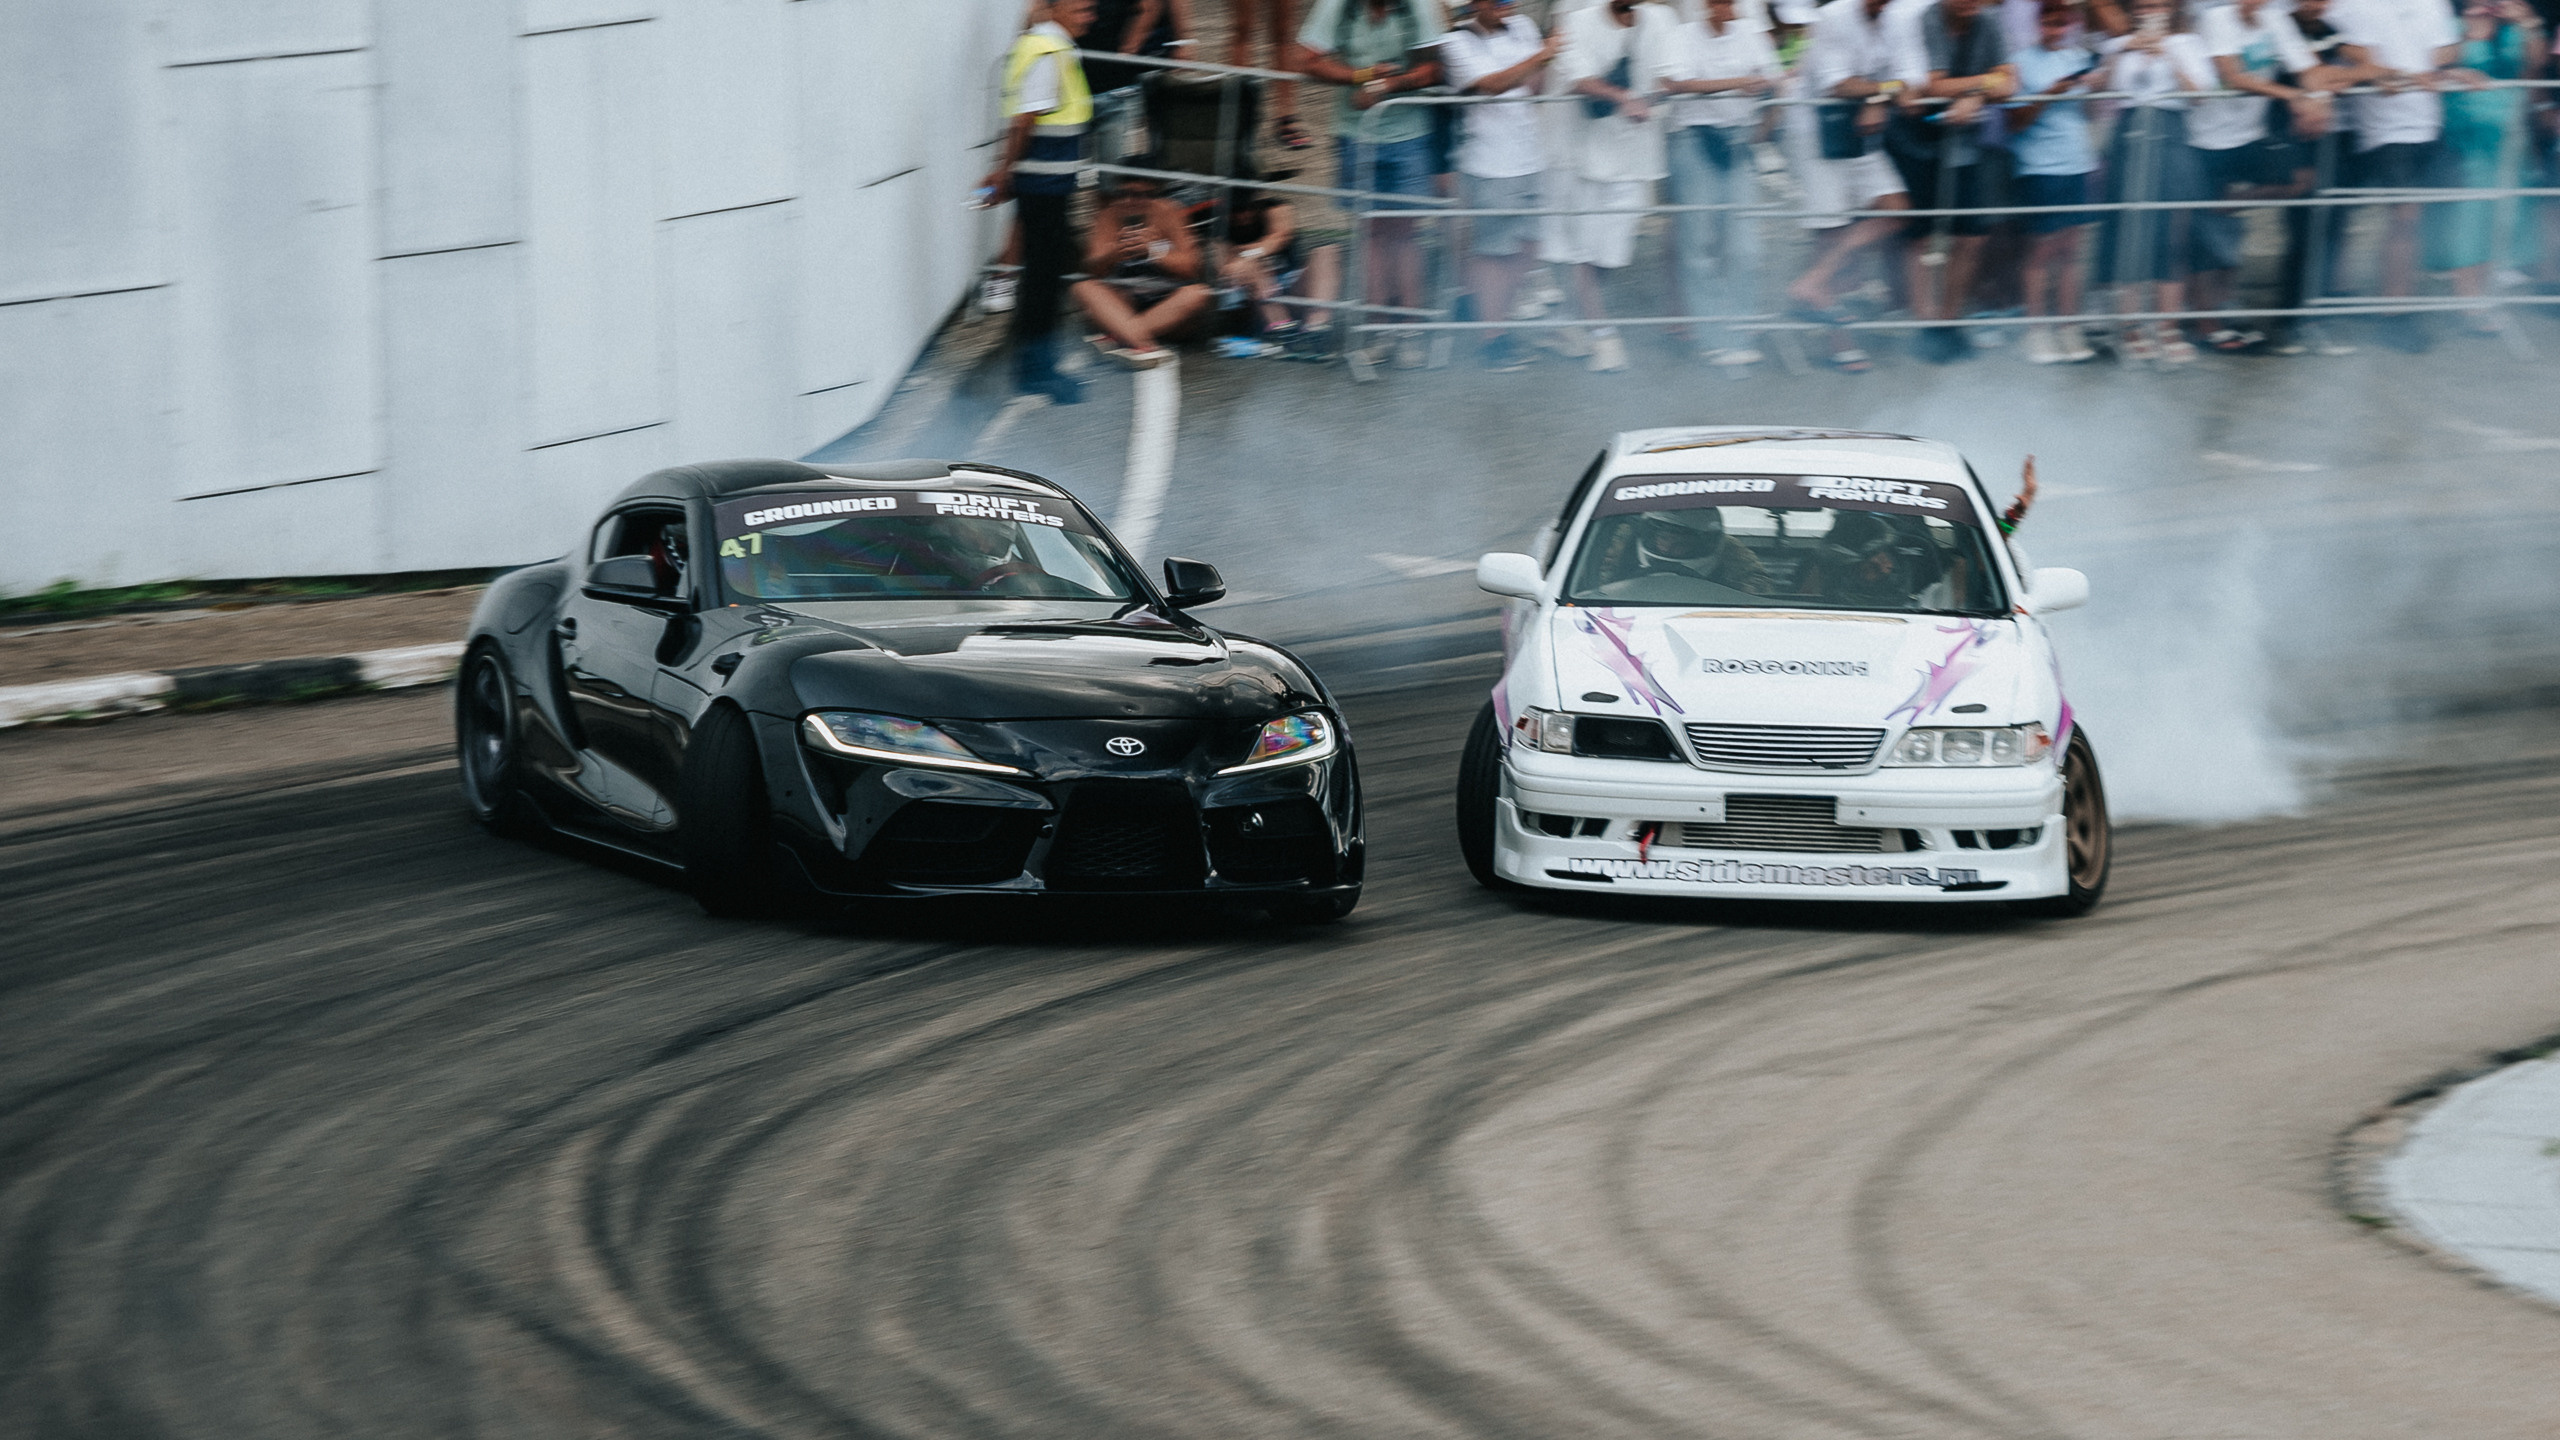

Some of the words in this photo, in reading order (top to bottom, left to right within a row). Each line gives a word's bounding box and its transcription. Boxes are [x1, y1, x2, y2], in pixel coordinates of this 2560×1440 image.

[1614, 479, 1777, 501] GROUNDED
[1832, 477, 1931, 496] DRIFT
[946, 494, 1041, 513] DRIFT
[1808, 487, 1949, 511] FIGHTERS
[743, 497, 898, 527] GROUNDED
[935, 503, 1065, 527] FIGHTERS
[719, 532, 762, 559] 47
[1568, 857, 1979, 886] www.sidemasters.ru
